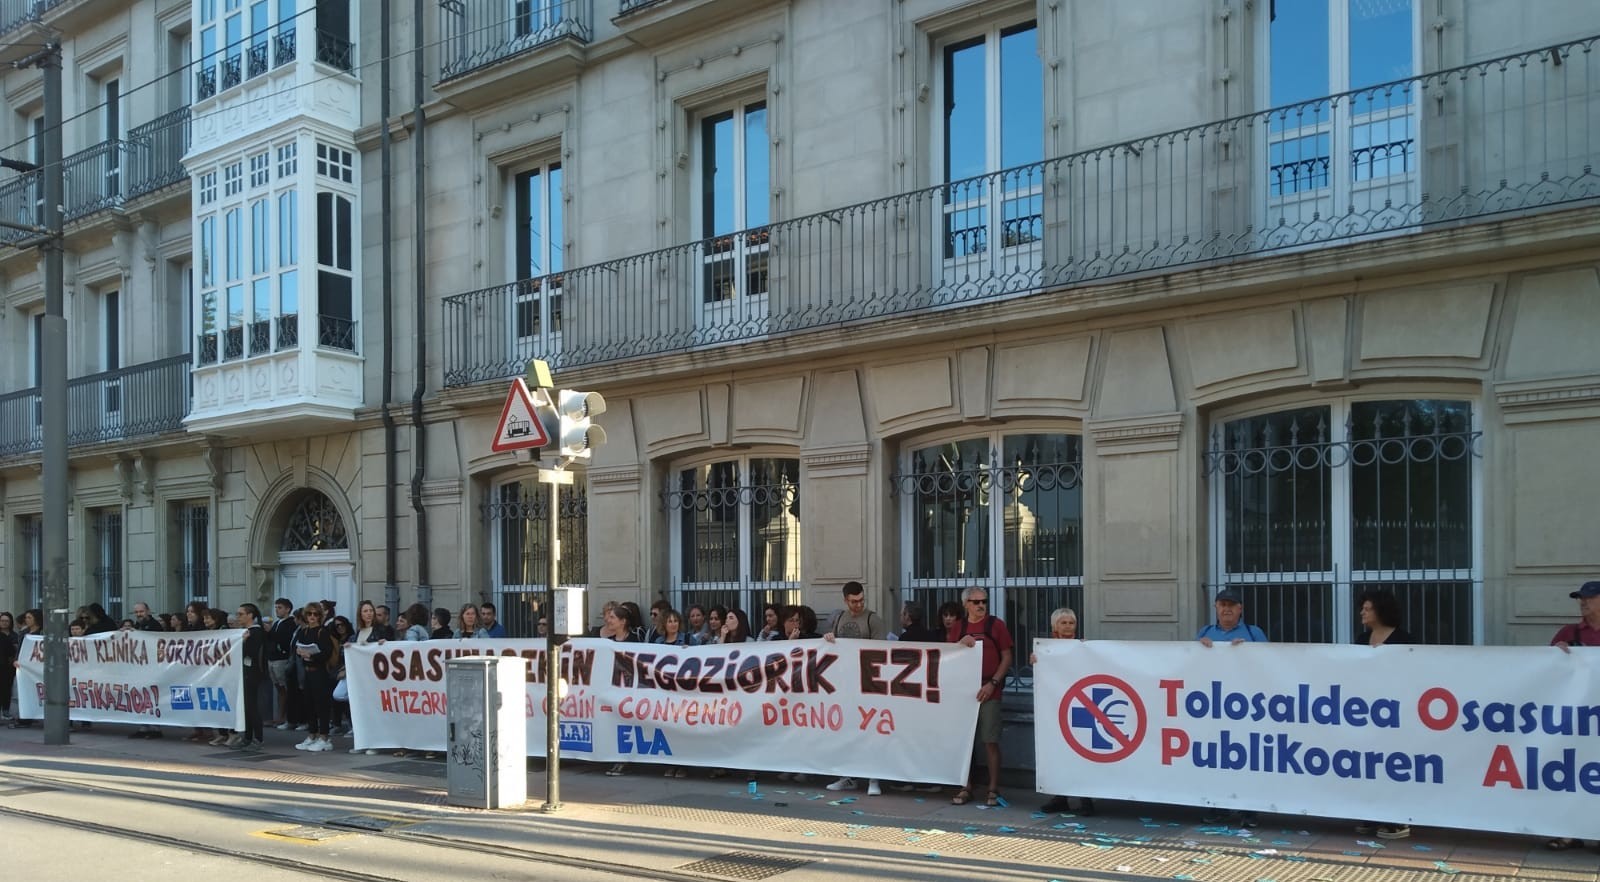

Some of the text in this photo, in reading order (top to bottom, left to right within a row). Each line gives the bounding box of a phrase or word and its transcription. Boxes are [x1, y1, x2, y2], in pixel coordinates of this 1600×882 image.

[196, 687, 231, 712] ELA
[859, 648, 941, 703] EZ!
[1159, 679, 1600, 737] Tolosaldea Osasun
[617, 724, 672, 756] ELA
[1161, 728, 1600, 795] Publikoaren Alde
